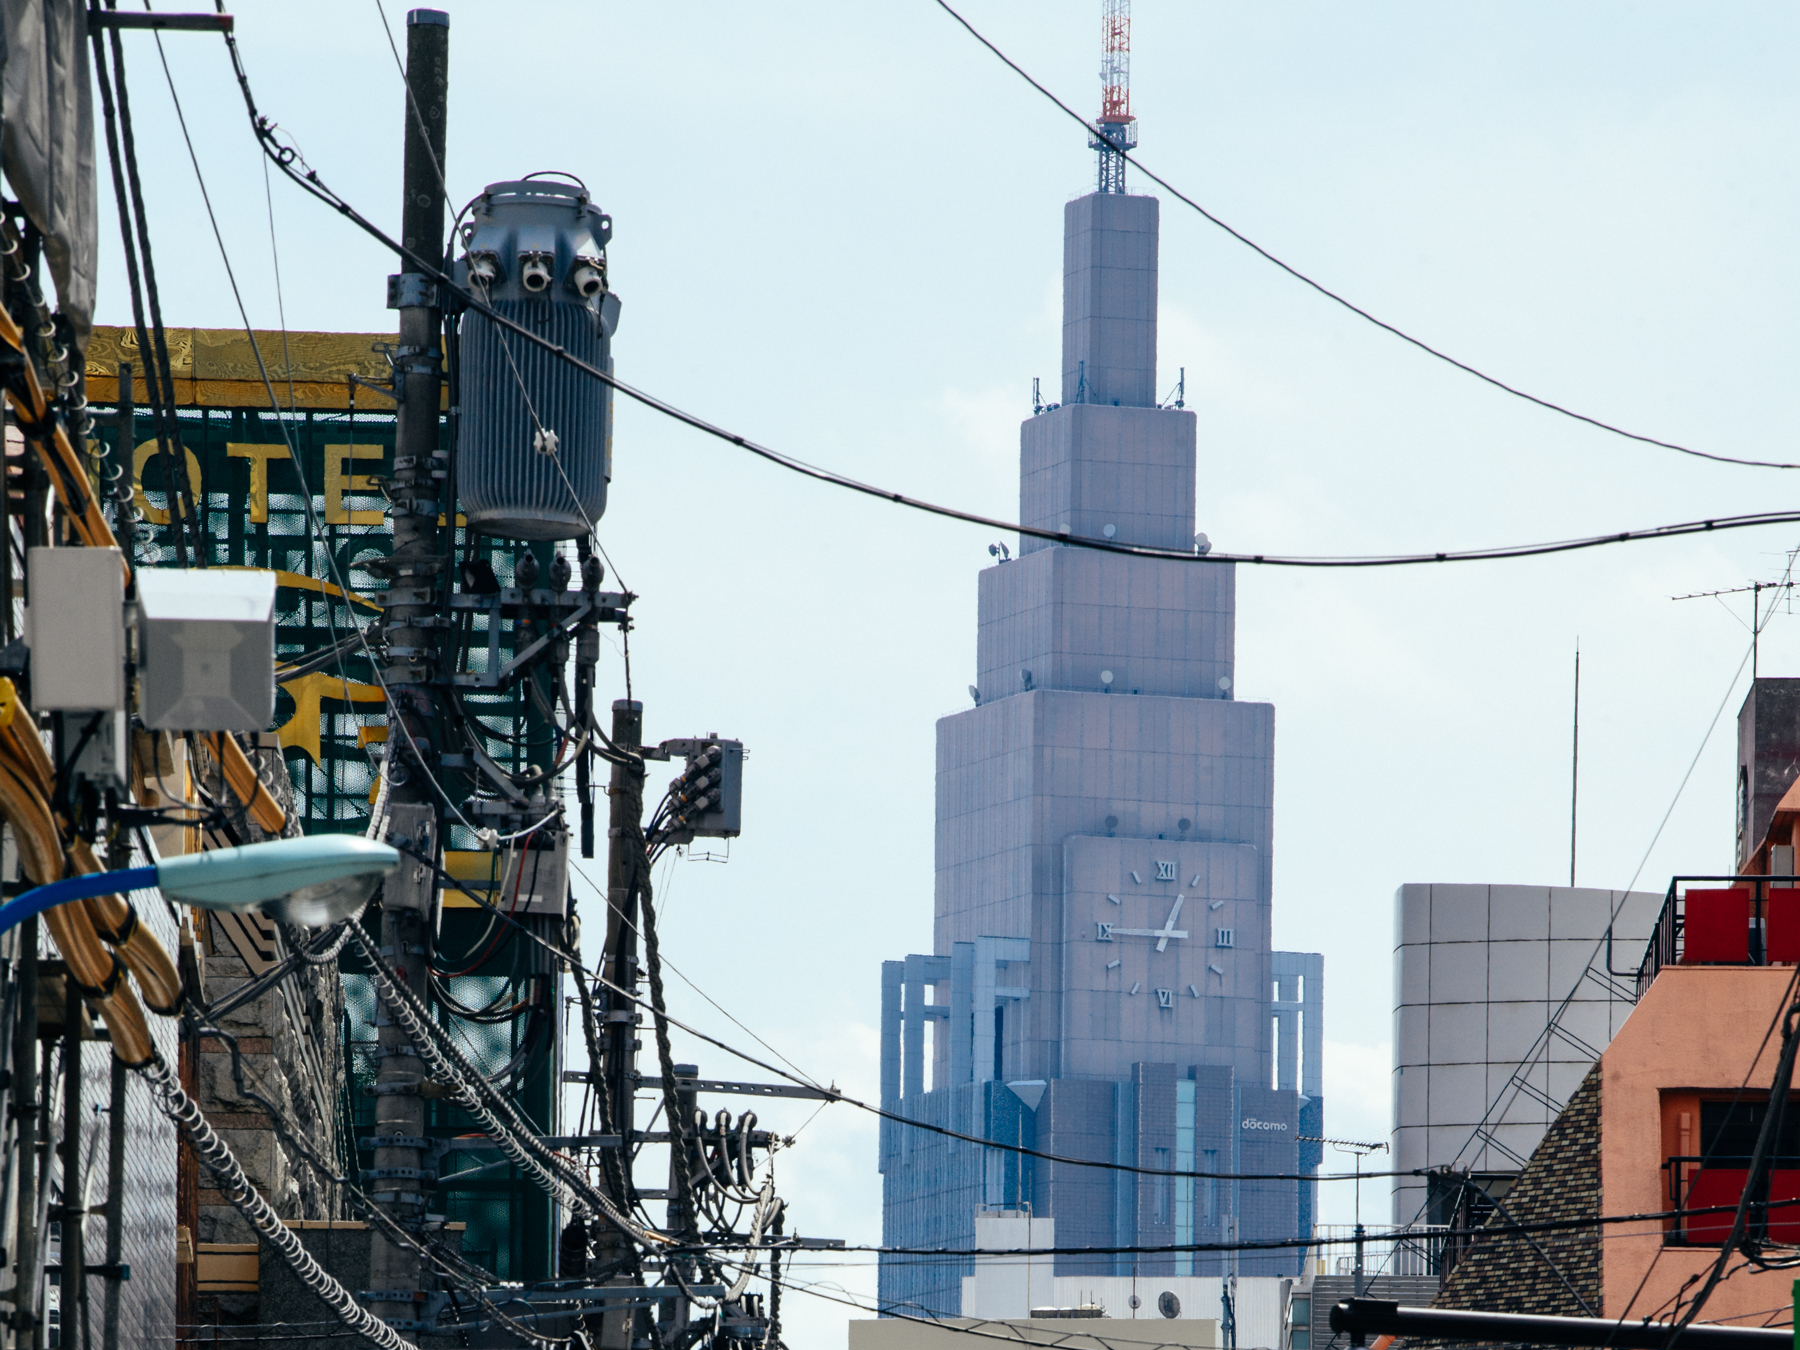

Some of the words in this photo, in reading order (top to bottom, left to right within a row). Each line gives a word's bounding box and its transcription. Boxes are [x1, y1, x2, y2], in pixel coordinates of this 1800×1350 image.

[1156, 861, 1177, 880] XII
[1216, 928, 1234, 947] III
[1157, 988, 1173, 1008] VI
[1242, 1118, 1287, 1131] docomo
